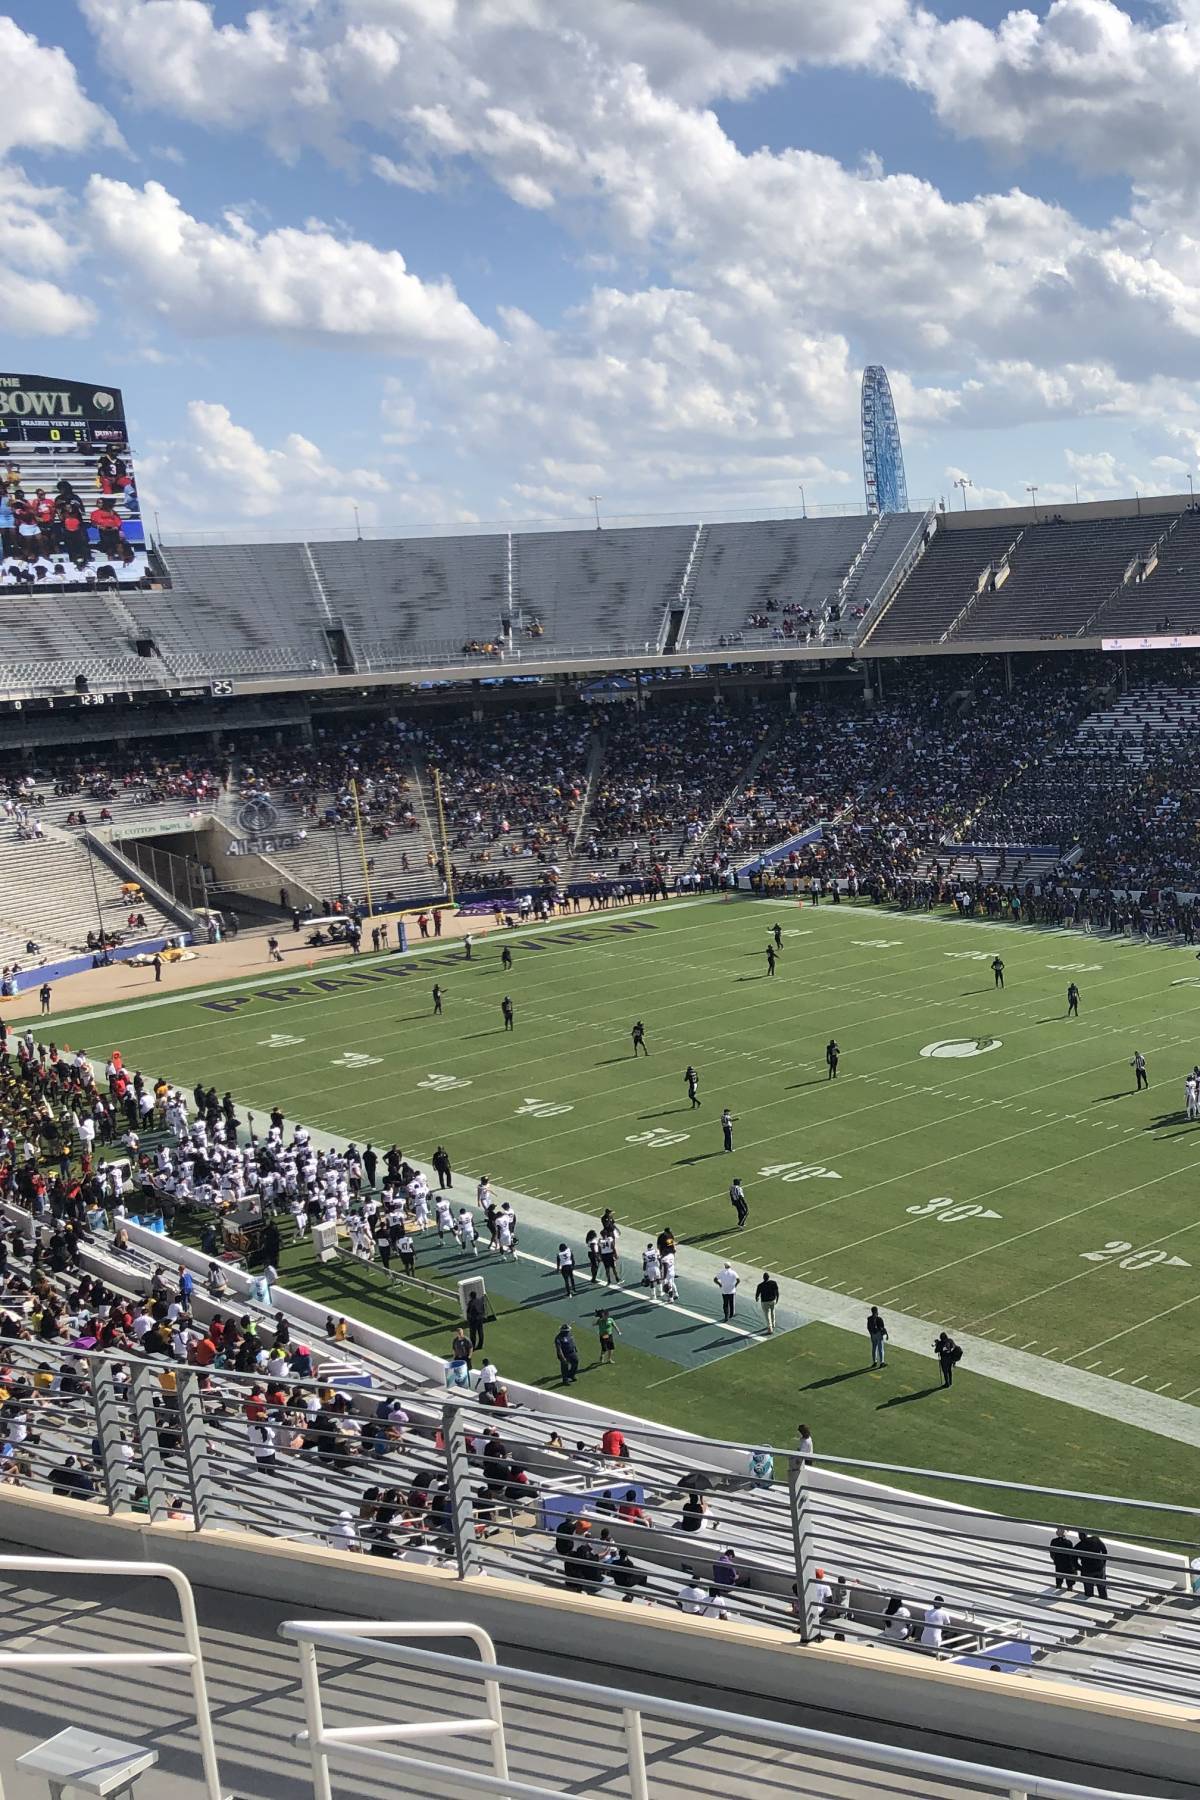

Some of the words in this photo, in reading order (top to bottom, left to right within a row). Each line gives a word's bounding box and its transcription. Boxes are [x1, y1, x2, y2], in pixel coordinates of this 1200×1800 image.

[50, 429, 60, 441] 0
[214, 681, 232, 694] 25
[14, 701, 22, 710] 0
[80, 694, 105, 705] 12:38
[199, 951, 488, 1013] PRAIRIE
[490, 920, 660, 952] VIEW
[625, 1128, 691, 1148] 50
[757, 1161, 827, 1182] 40
[906, 1197, 983, 1222] 30
[1079, 1241, 1168, 1270] 20
